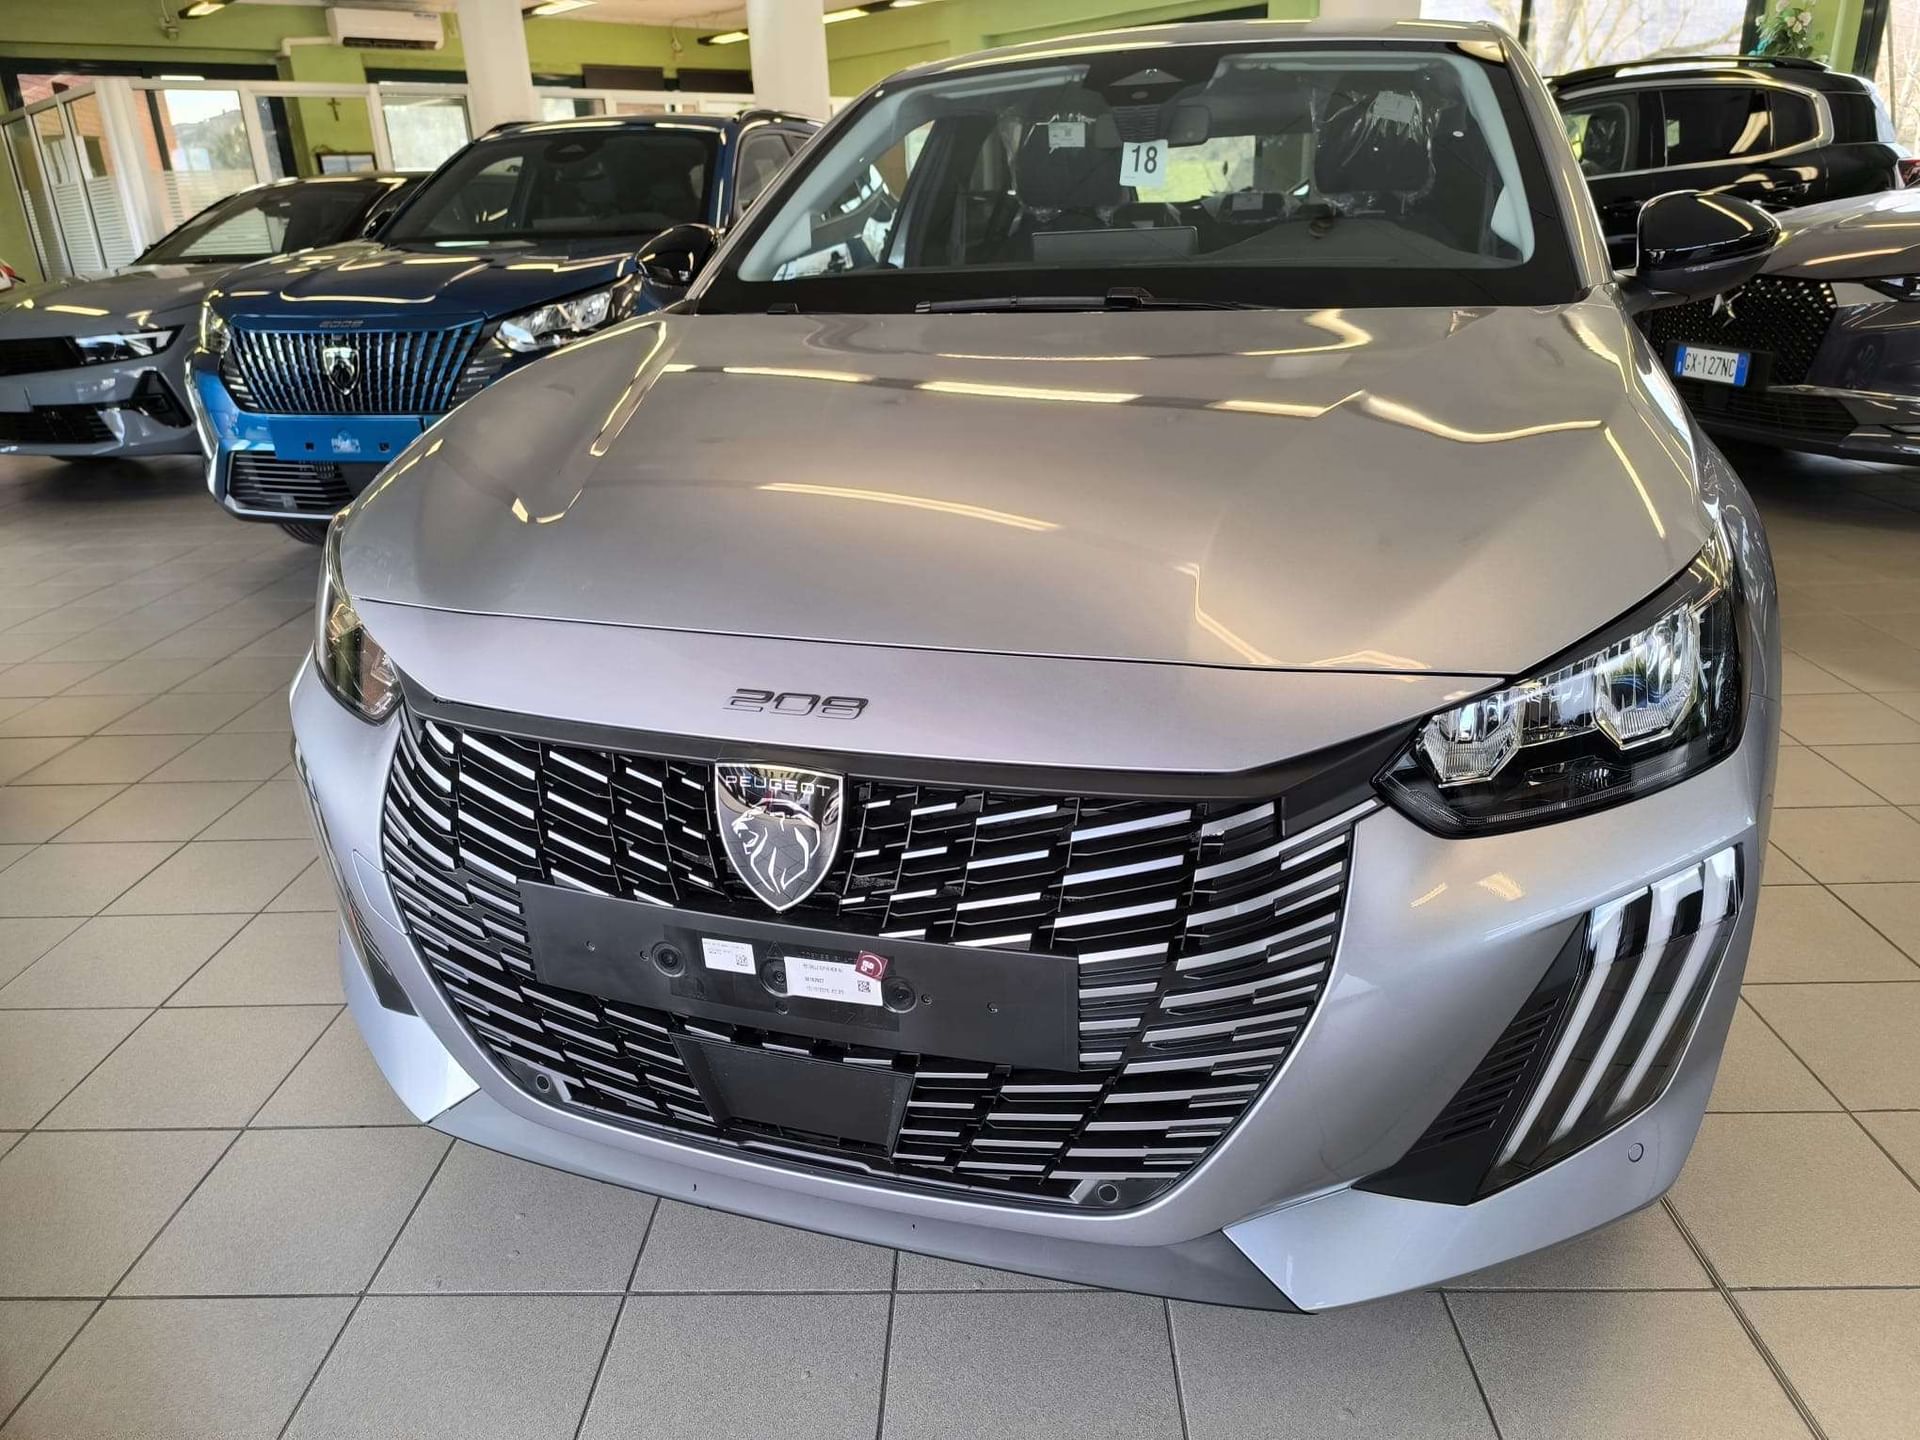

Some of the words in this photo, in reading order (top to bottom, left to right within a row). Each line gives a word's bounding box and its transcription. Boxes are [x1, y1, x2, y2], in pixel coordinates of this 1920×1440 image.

[1132, 145, 1158, 174] 18
[722, 688, 869, 720] 208
[725, 775, 831, 797] PEUGEOT
